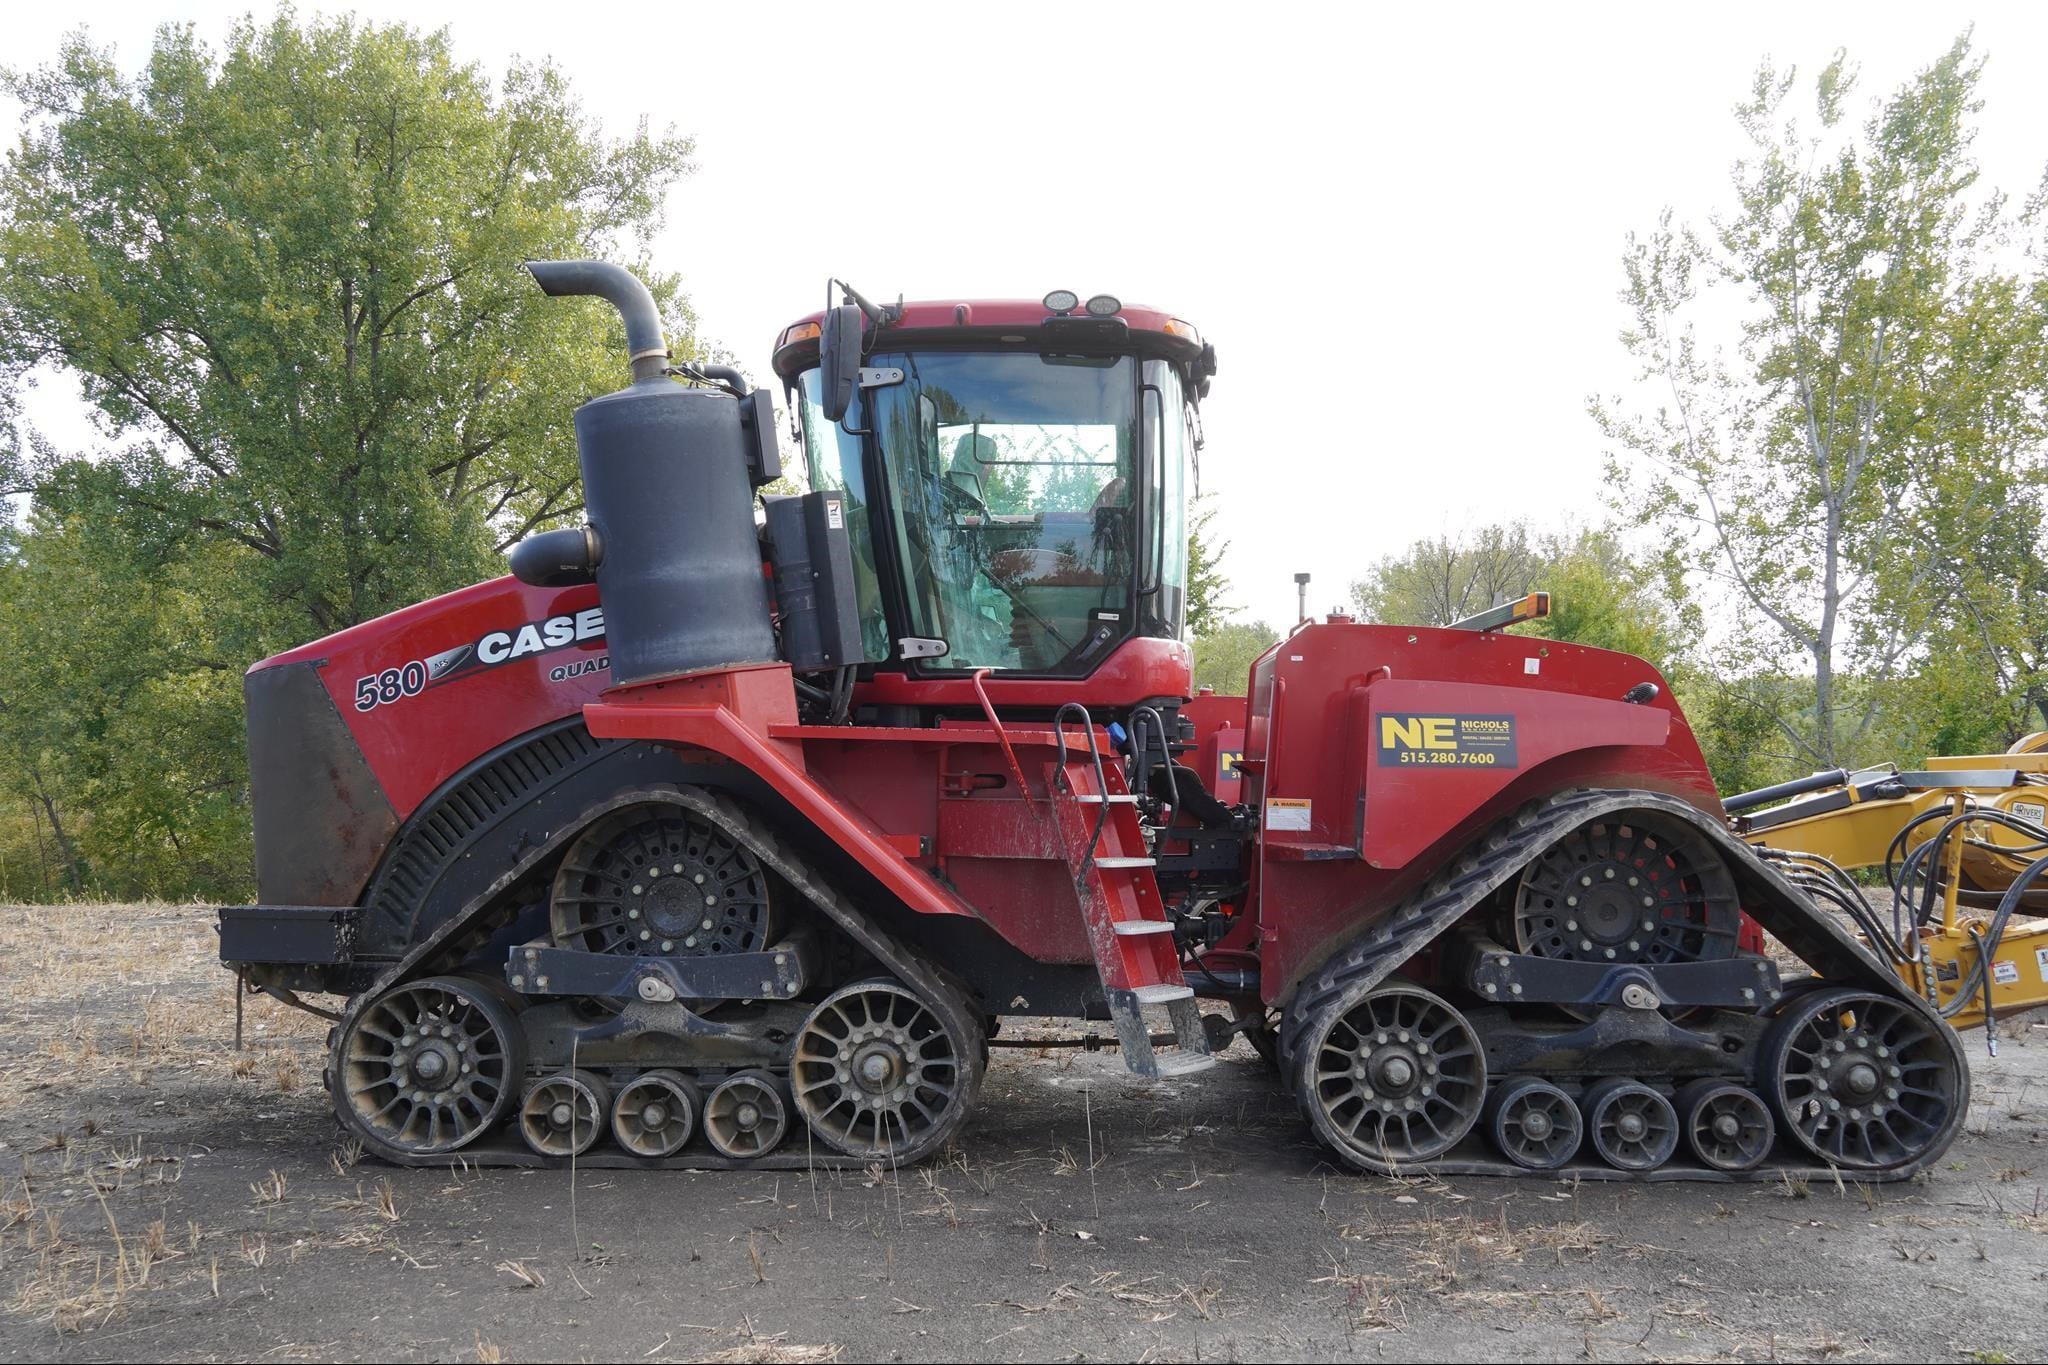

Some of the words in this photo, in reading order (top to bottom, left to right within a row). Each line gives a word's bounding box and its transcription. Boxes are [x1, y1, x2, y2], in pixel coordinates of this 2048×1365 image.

[477, 607, 605, 664] CASE
[354, 660, 426, 712] 580
[1381, 717, 1457, 750] NE
[1461, 720, 1509, 729] NICHOLS
[1401, 752, 1495, 764] 515.280.7600
